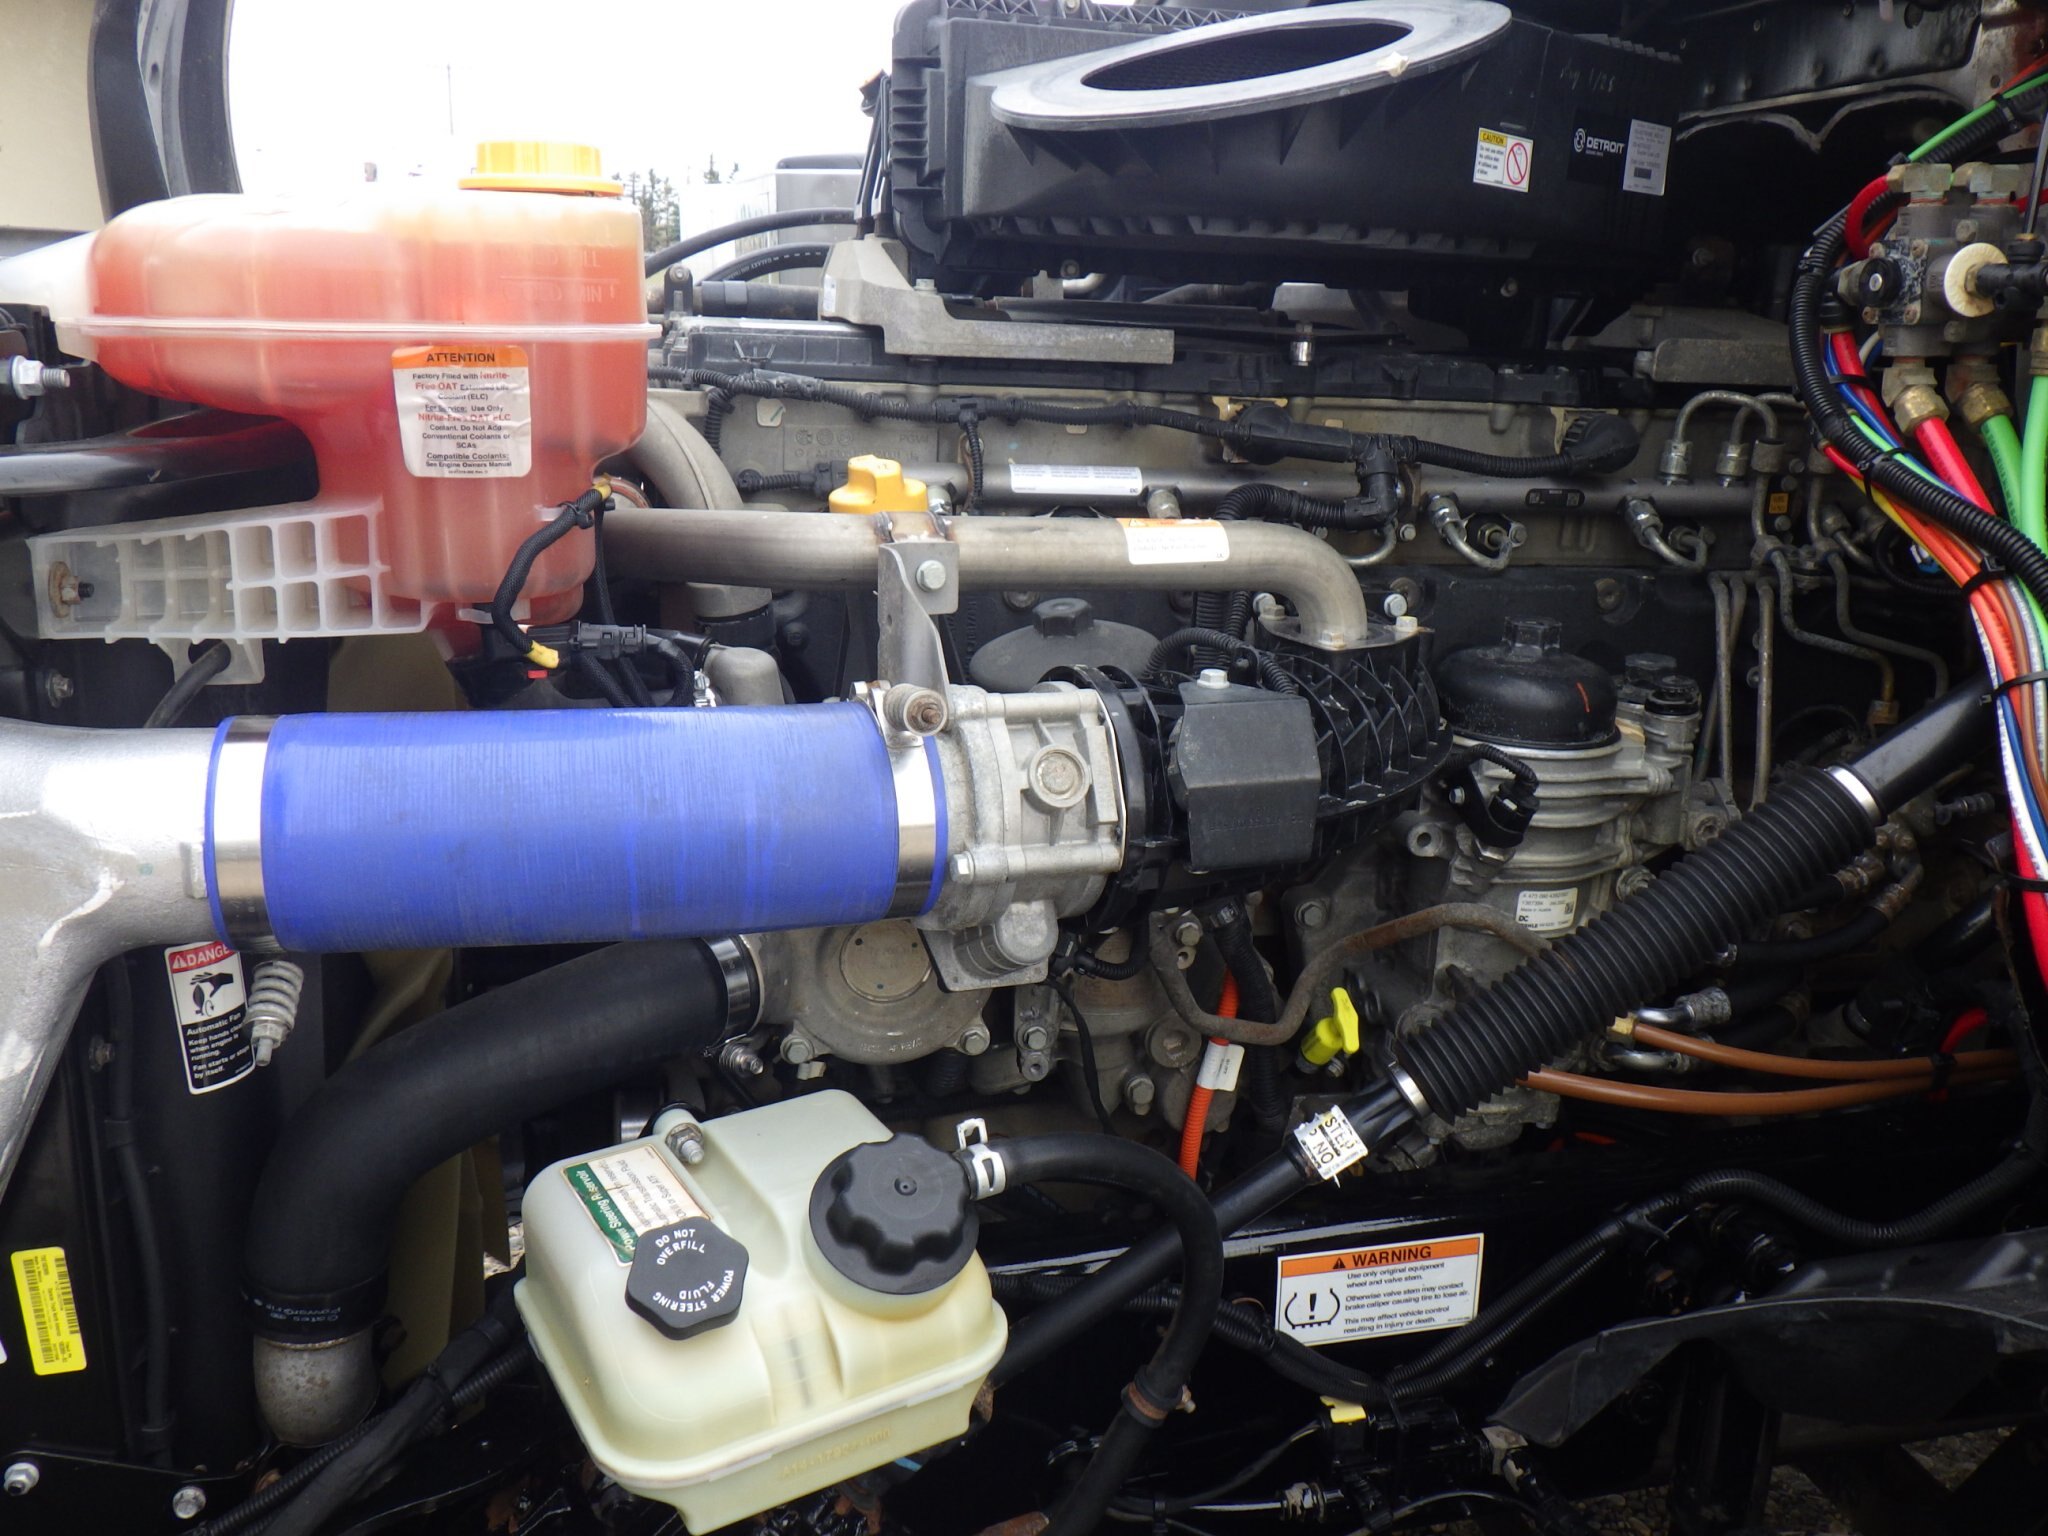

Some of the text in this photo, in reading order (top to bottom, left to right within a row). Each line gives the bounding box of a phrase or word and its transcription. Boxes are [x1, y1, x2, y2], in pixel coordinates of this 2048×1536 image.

[1482, 132, 1504, 145] CAUTION
[1586, 136, 1625, 154] DETROIT
[426, 352, 496, 363] ATTENTION
[412, 373, 440, 381] Factory
[441, 372, 462, 380] Filled
[463, 372, 479, 380] with
[415, 382, 437, 391] Free
[438, 382, 458, 391] OAT
[426, 453, 470, 461] Compatible
[438, 461, 460, 469] Engine
[187, 943, 230, 966] DANGE
[187, 1012, 242, 1036] Automatic Fan
[188, 1023, 243, 1047] Keep hands clea
[190, 1033, 239, 1054] when engine is
[191, 1050, 221, 1061] running.
[193, 1063, 207, 1072] Fan
[208, 1056, 229, 1068] starts
[194, 1071, 204, 1079] by
[205, 1066, 225, 1077] itself.
[1325, 1116, 1355, 1149] STEP
[1313, 1141, 1334, 1164] NO
[576, 1170, 636, 1251] Power Steering Rservoir
[655, 1228, 697, 1249] DO NOT
[656, 1240, 706, 1266] OVERFILL
[1352, 1246, 1432, 1267] WARNING
[1347, 1261, 1446, 1280] Use only original equipment
[679, 1280, 716, 1300] FLUID
[1346, 1274, 1423, 1288] wheel and valve stem.
[652, 1269, 735, 1313] POWER STEERING
[1344, 1302, 1366, 1311] brake
[1366, 1299, 1391, 1310] caliper
[1391, 1296, 1420, 1307] causing
[1442, 1291, 1458, 1299] lose
[1458, 1289, 1471, 1297] air.
[1345, 1281, 1464, 1302] Otherwise valve stem may contact
[1343, 1324, 1375, 1334] resulting
[1376, 1322, 1383, 1330] in
[1414, 1315, 1436, 1325] death.
[1344, 1306, 1450, 1325] This may affect vehicle control
